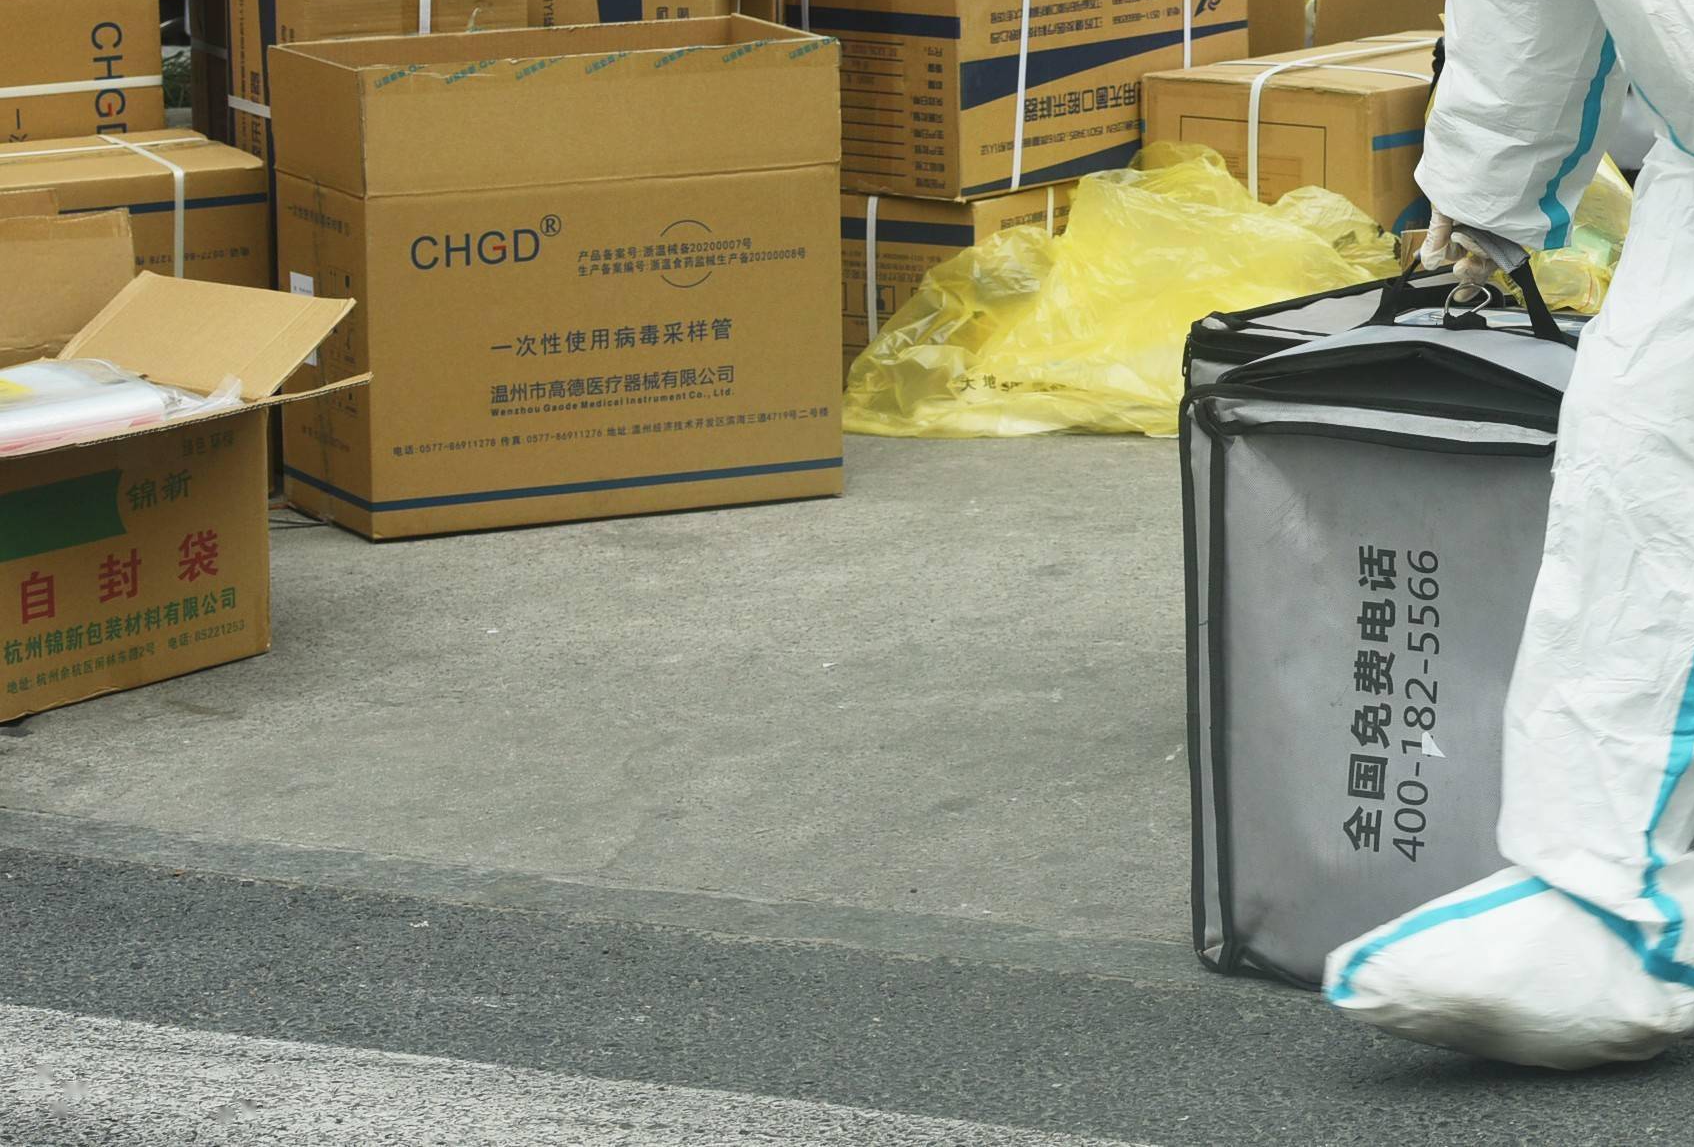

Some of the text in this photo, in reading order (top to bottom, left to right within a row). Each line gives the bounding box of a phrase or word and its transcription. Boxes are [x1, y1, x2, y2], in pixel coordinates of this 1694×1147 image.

[1024, 82, 1141, 122] 用无菌口腔采样器
[491, 318, 734, 357] 一次性使用病毒采样管
[490, 365, 735, 405] 温州市高德医疗器械有限公司
[491, 406, 541, 417] Wenzhou
[543, 402, 578, 413] Gaode
[580, 398, 623, 410] Medical
[625, 392, 686, 405] Instrument
[126, 469, 192, 511] 锦新
[21, 529, 219, 625] 自封袋
[4, 587, 236, 665] 杭州锦新包装材料有限公司
[1343, 544, 1398, 853] 全国免费电话
[1391, 549, 1441, 863] 400-182-5566
